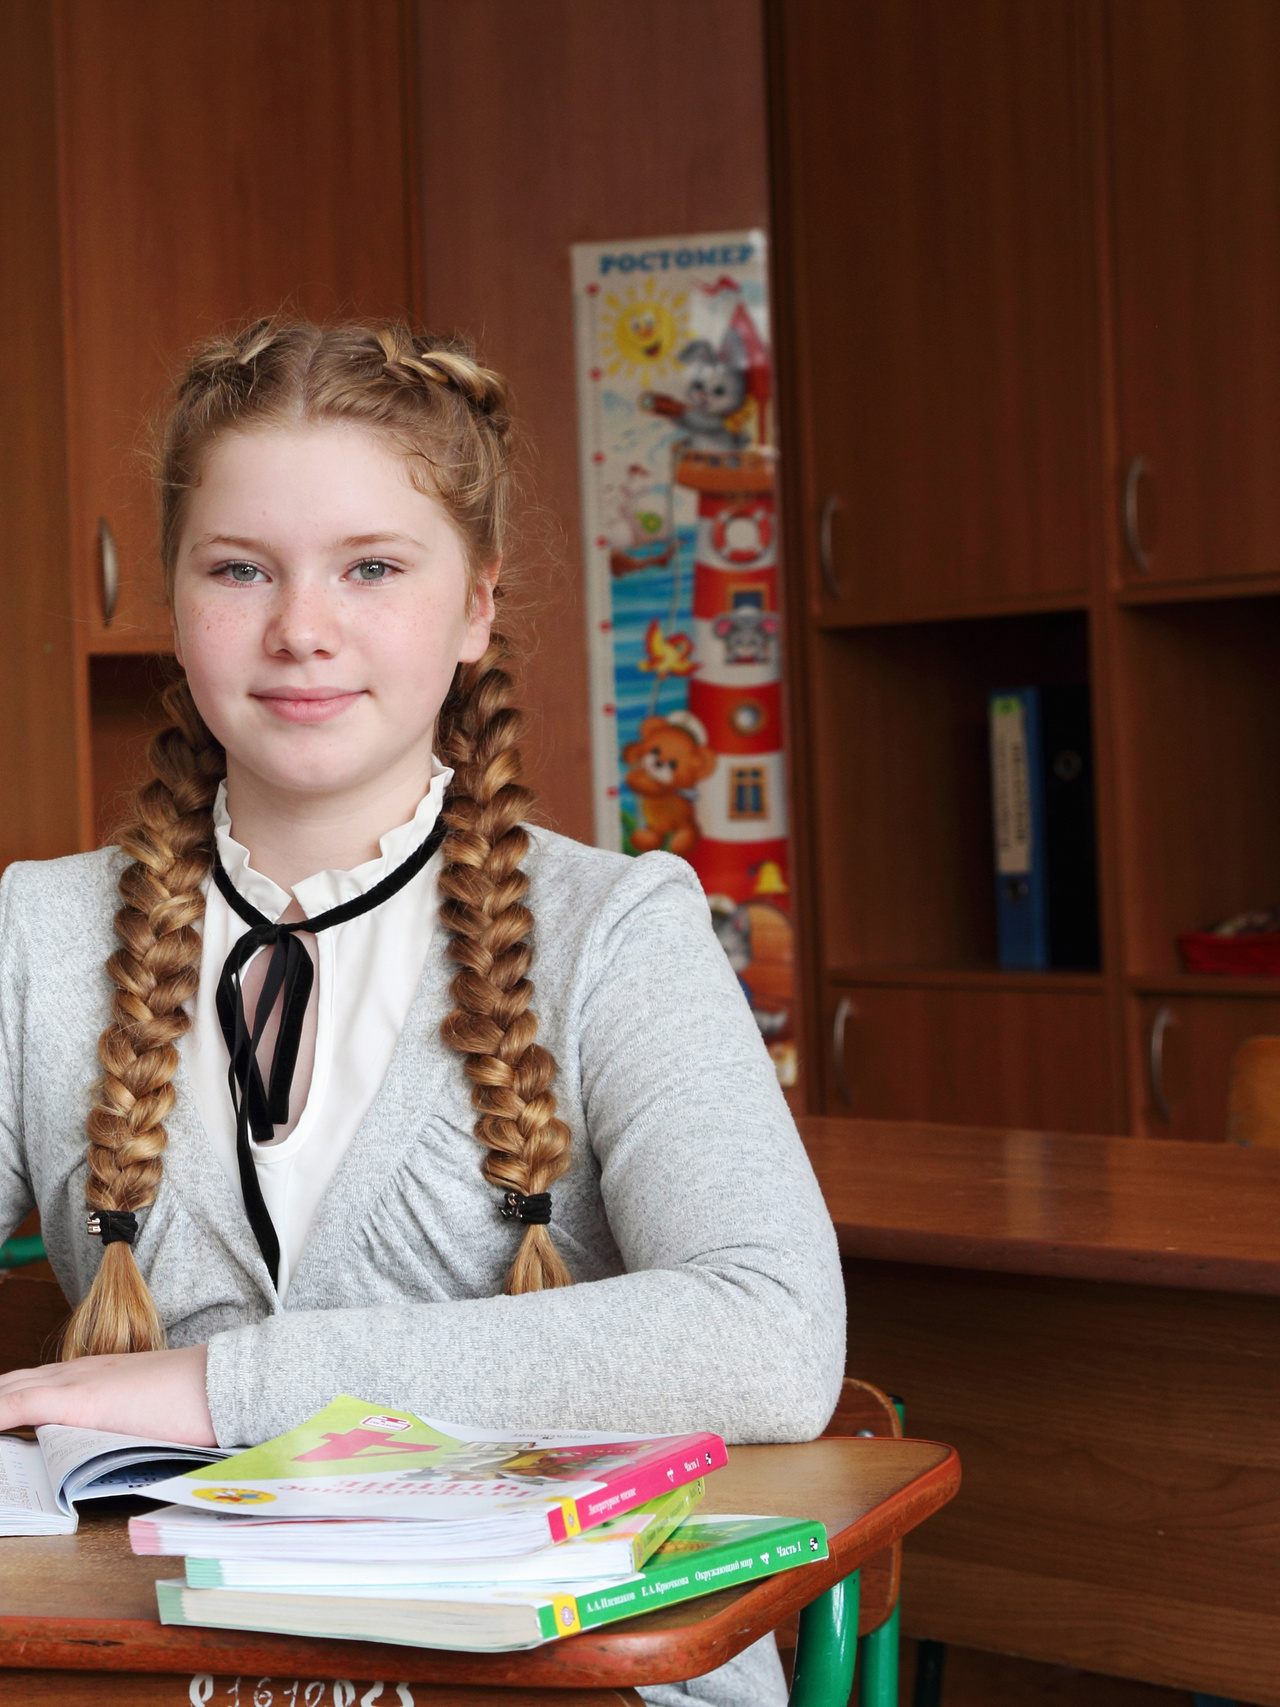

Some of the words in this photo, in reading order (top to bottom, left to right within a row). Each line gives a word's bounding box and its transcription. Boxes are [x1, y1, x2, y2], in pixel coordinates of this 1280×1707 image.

[599, 243, 755, 275] РОСТОМЕР
[289, 1428, 442, 1463] 4
[695, 1561, 740, 1582] Окружающий
[739, 1557, 754, 1571] мир
[776, 1542, 797, 1558] Часть
